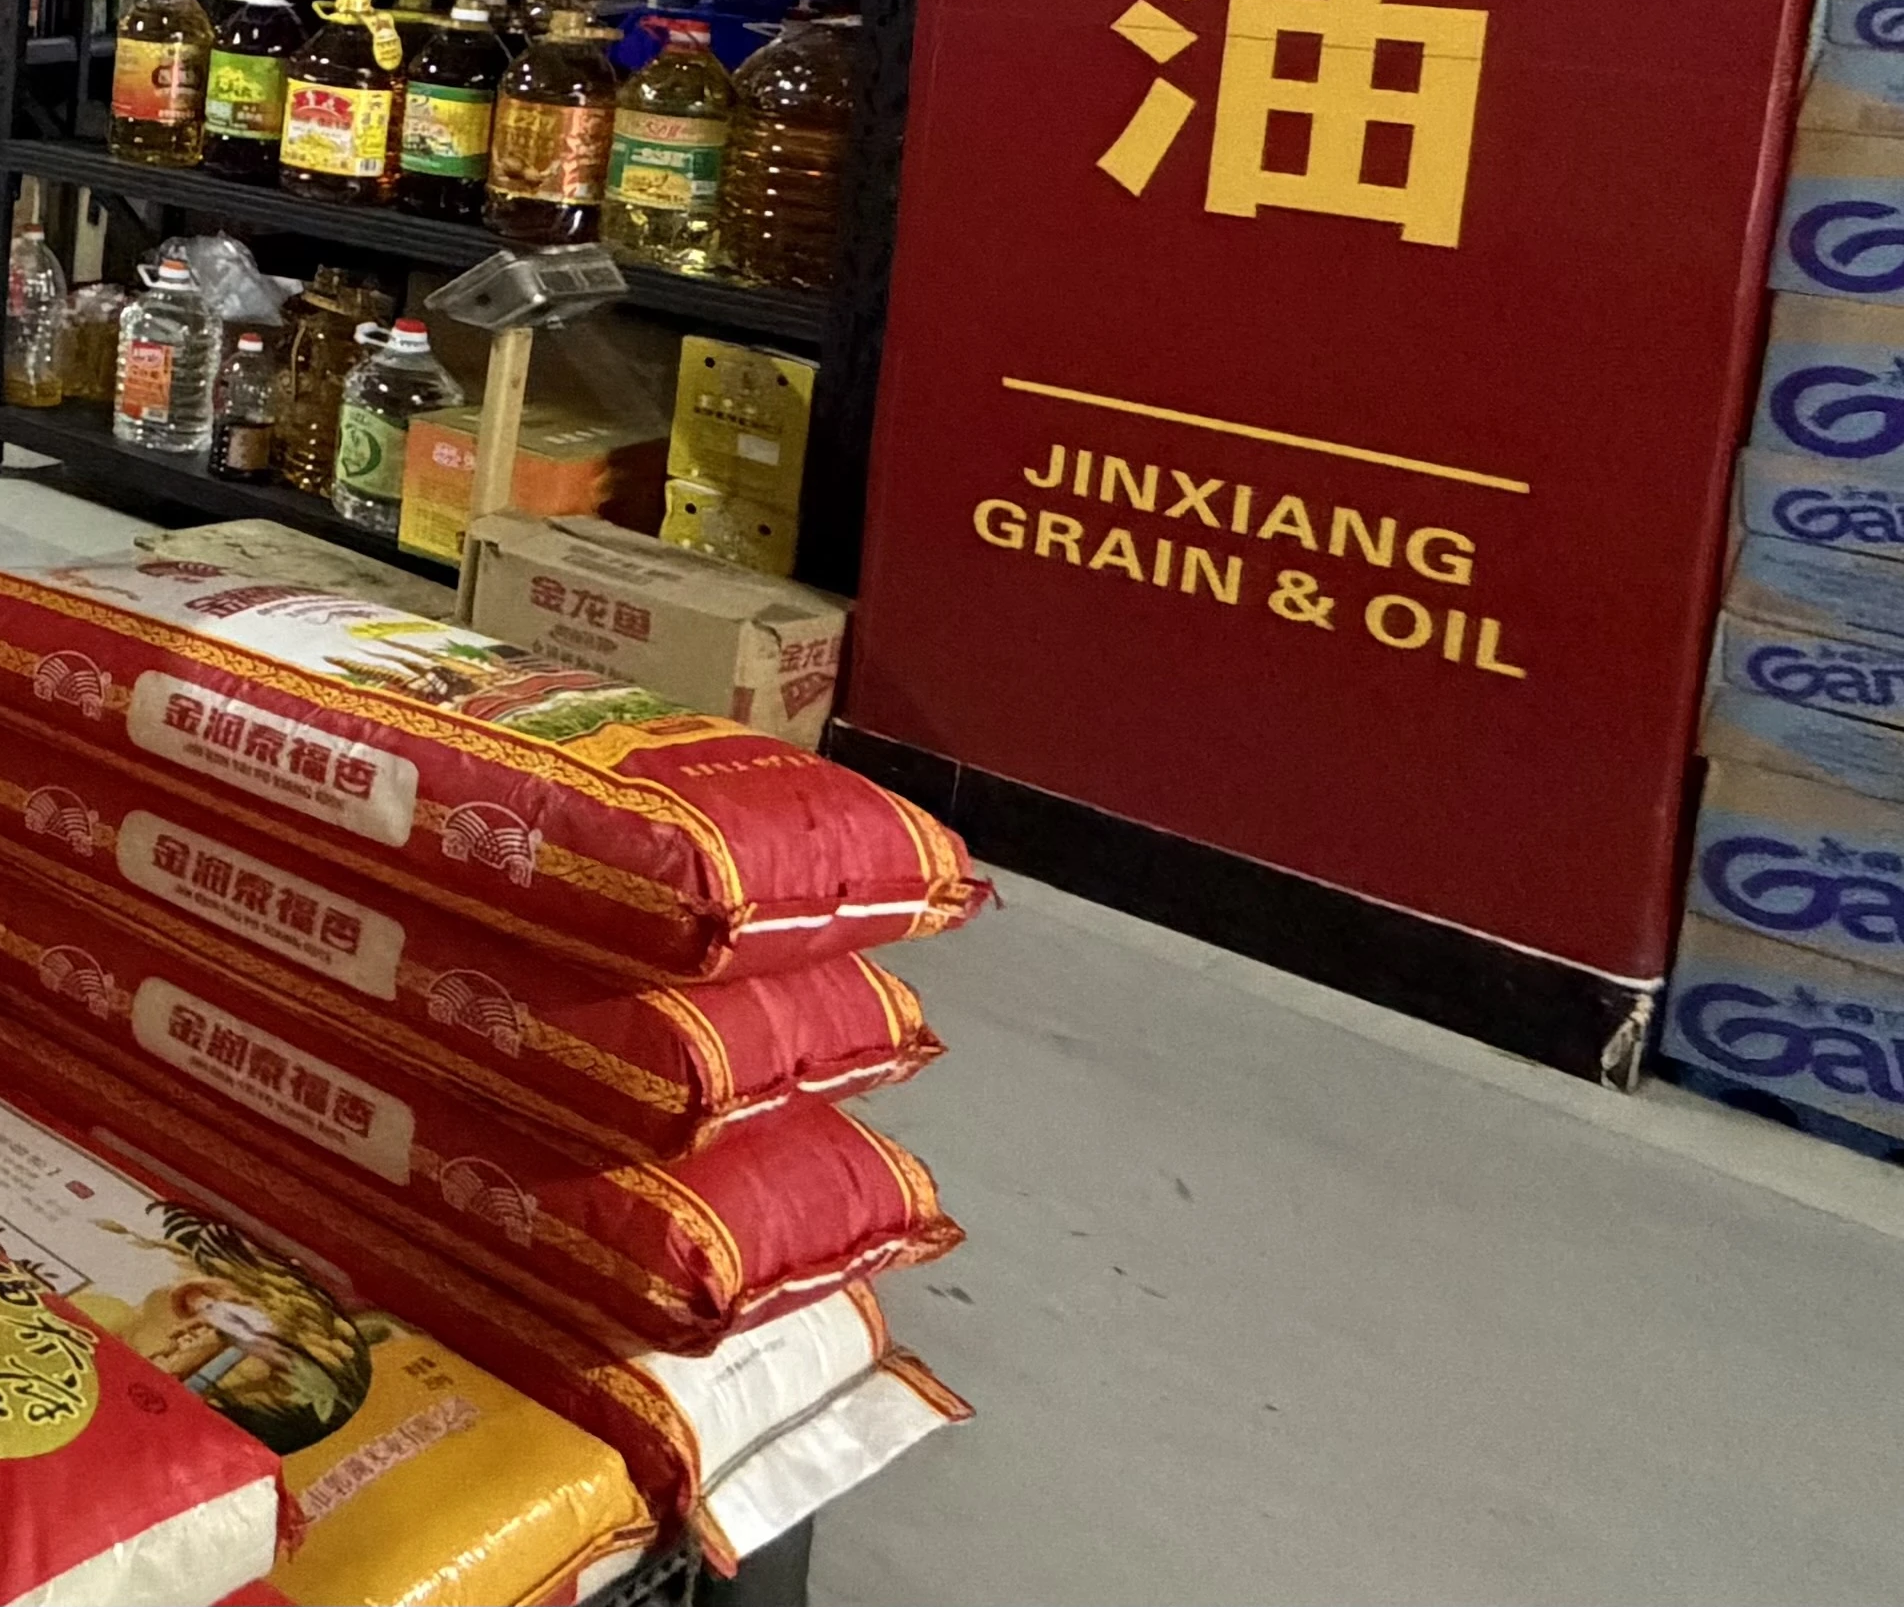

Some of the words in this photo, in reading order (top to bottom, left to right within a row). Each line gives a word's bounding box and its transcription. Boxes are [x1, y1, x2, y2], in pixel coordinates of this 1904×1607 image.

[1022, 441, 1478, 587] JINXIANG
[530, 575, 654, 642] 金龙鱼
[971, 496, 1244, 608] GRAIN
[1267, 569, 1336, 632] &
[1364, 592, 1529, 681] OIL
